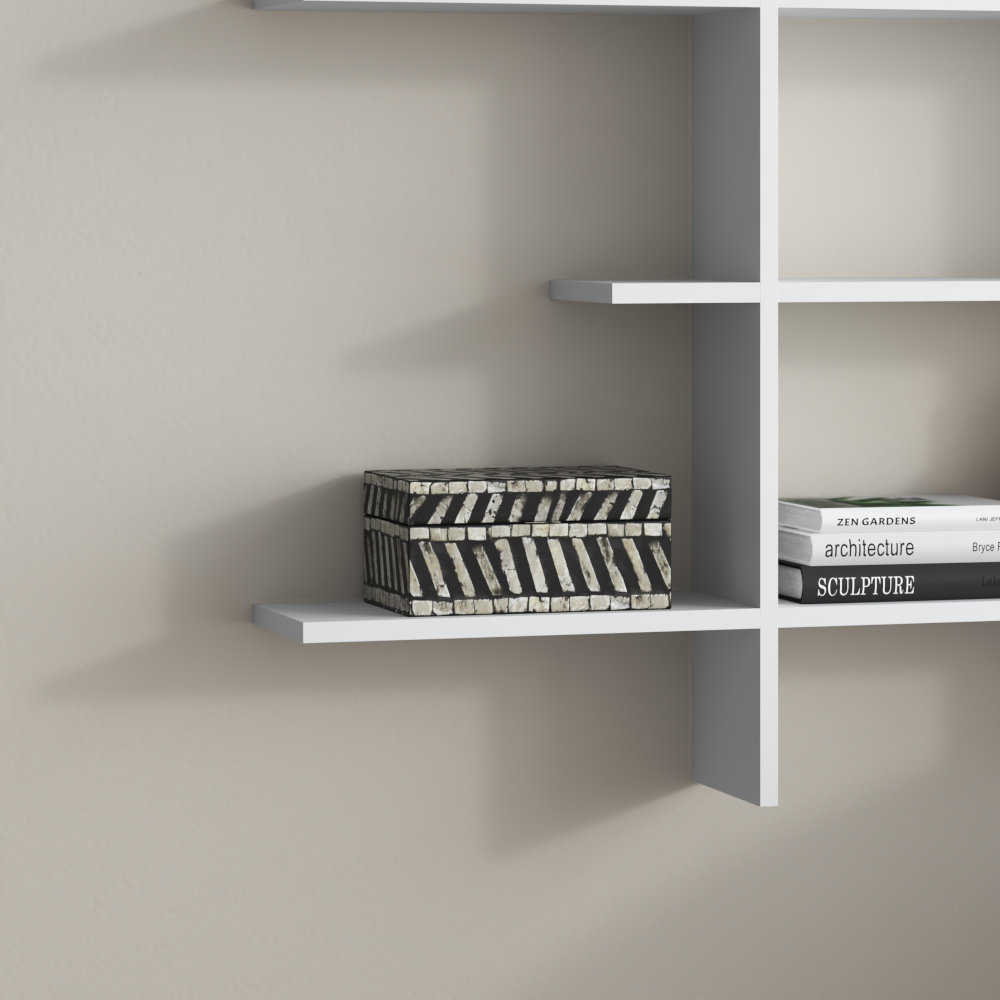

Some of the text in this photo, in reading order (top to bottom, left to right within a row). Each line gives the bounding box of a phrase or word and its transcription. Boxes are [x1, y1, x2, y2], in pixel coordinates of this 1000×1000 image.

[836, 516, 916, 526] ZEN GARDENS
[824, 538, 914, 558] architecture
[972, 541, 995, 554] Bryce
[817, 575, 915, 597] SCULPTURE
